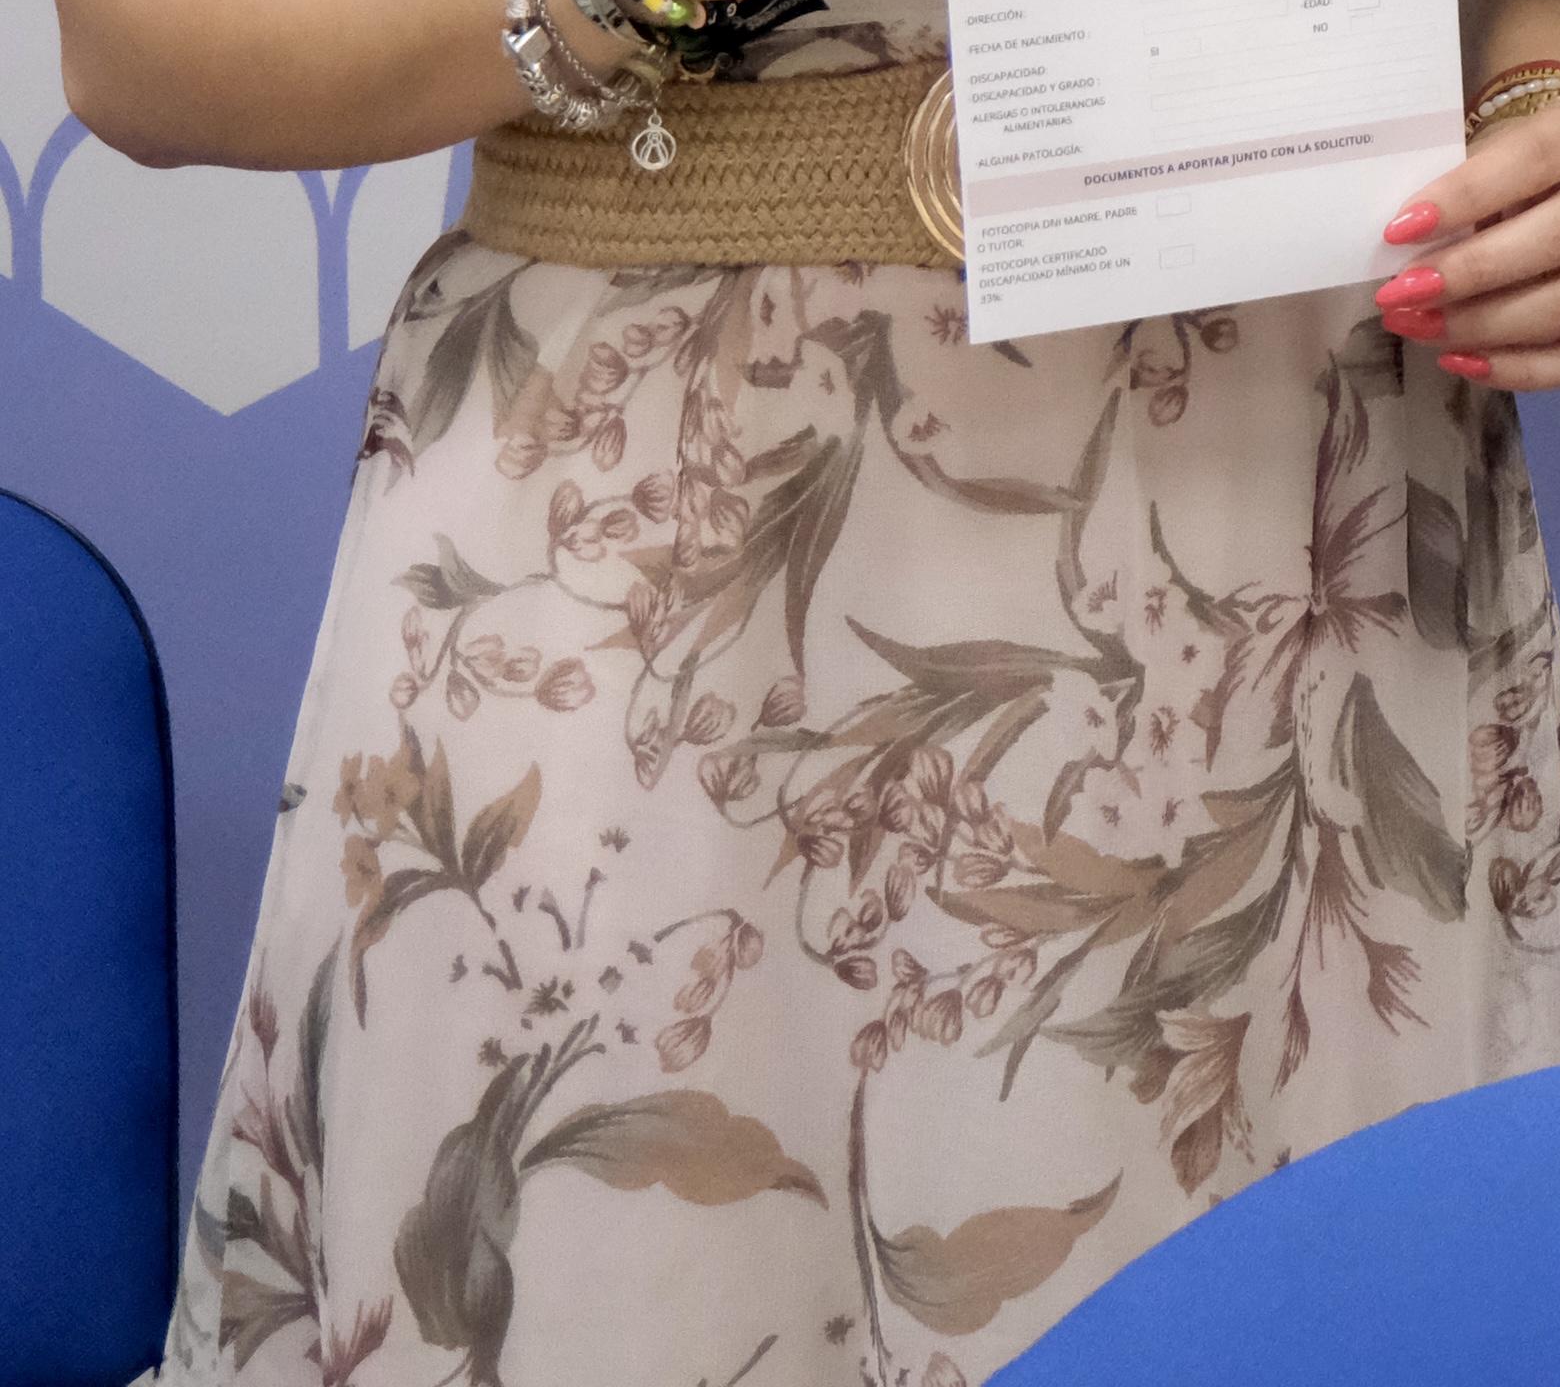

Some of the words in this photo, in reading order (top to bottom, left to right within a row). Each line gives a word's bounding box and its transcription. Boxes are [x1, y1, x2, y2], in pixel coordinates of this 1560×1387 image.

[1083, 164, 1165, 186] DOCUMENTOS
[1166, 163, 1175, 174] A
[1177, 155, 1230, 172] APORTAR
[1231, 149, 1268, 167] JUNTO
[1270, 145, 1295, 158] CON
[1297, 143, 1312, 154] LA
